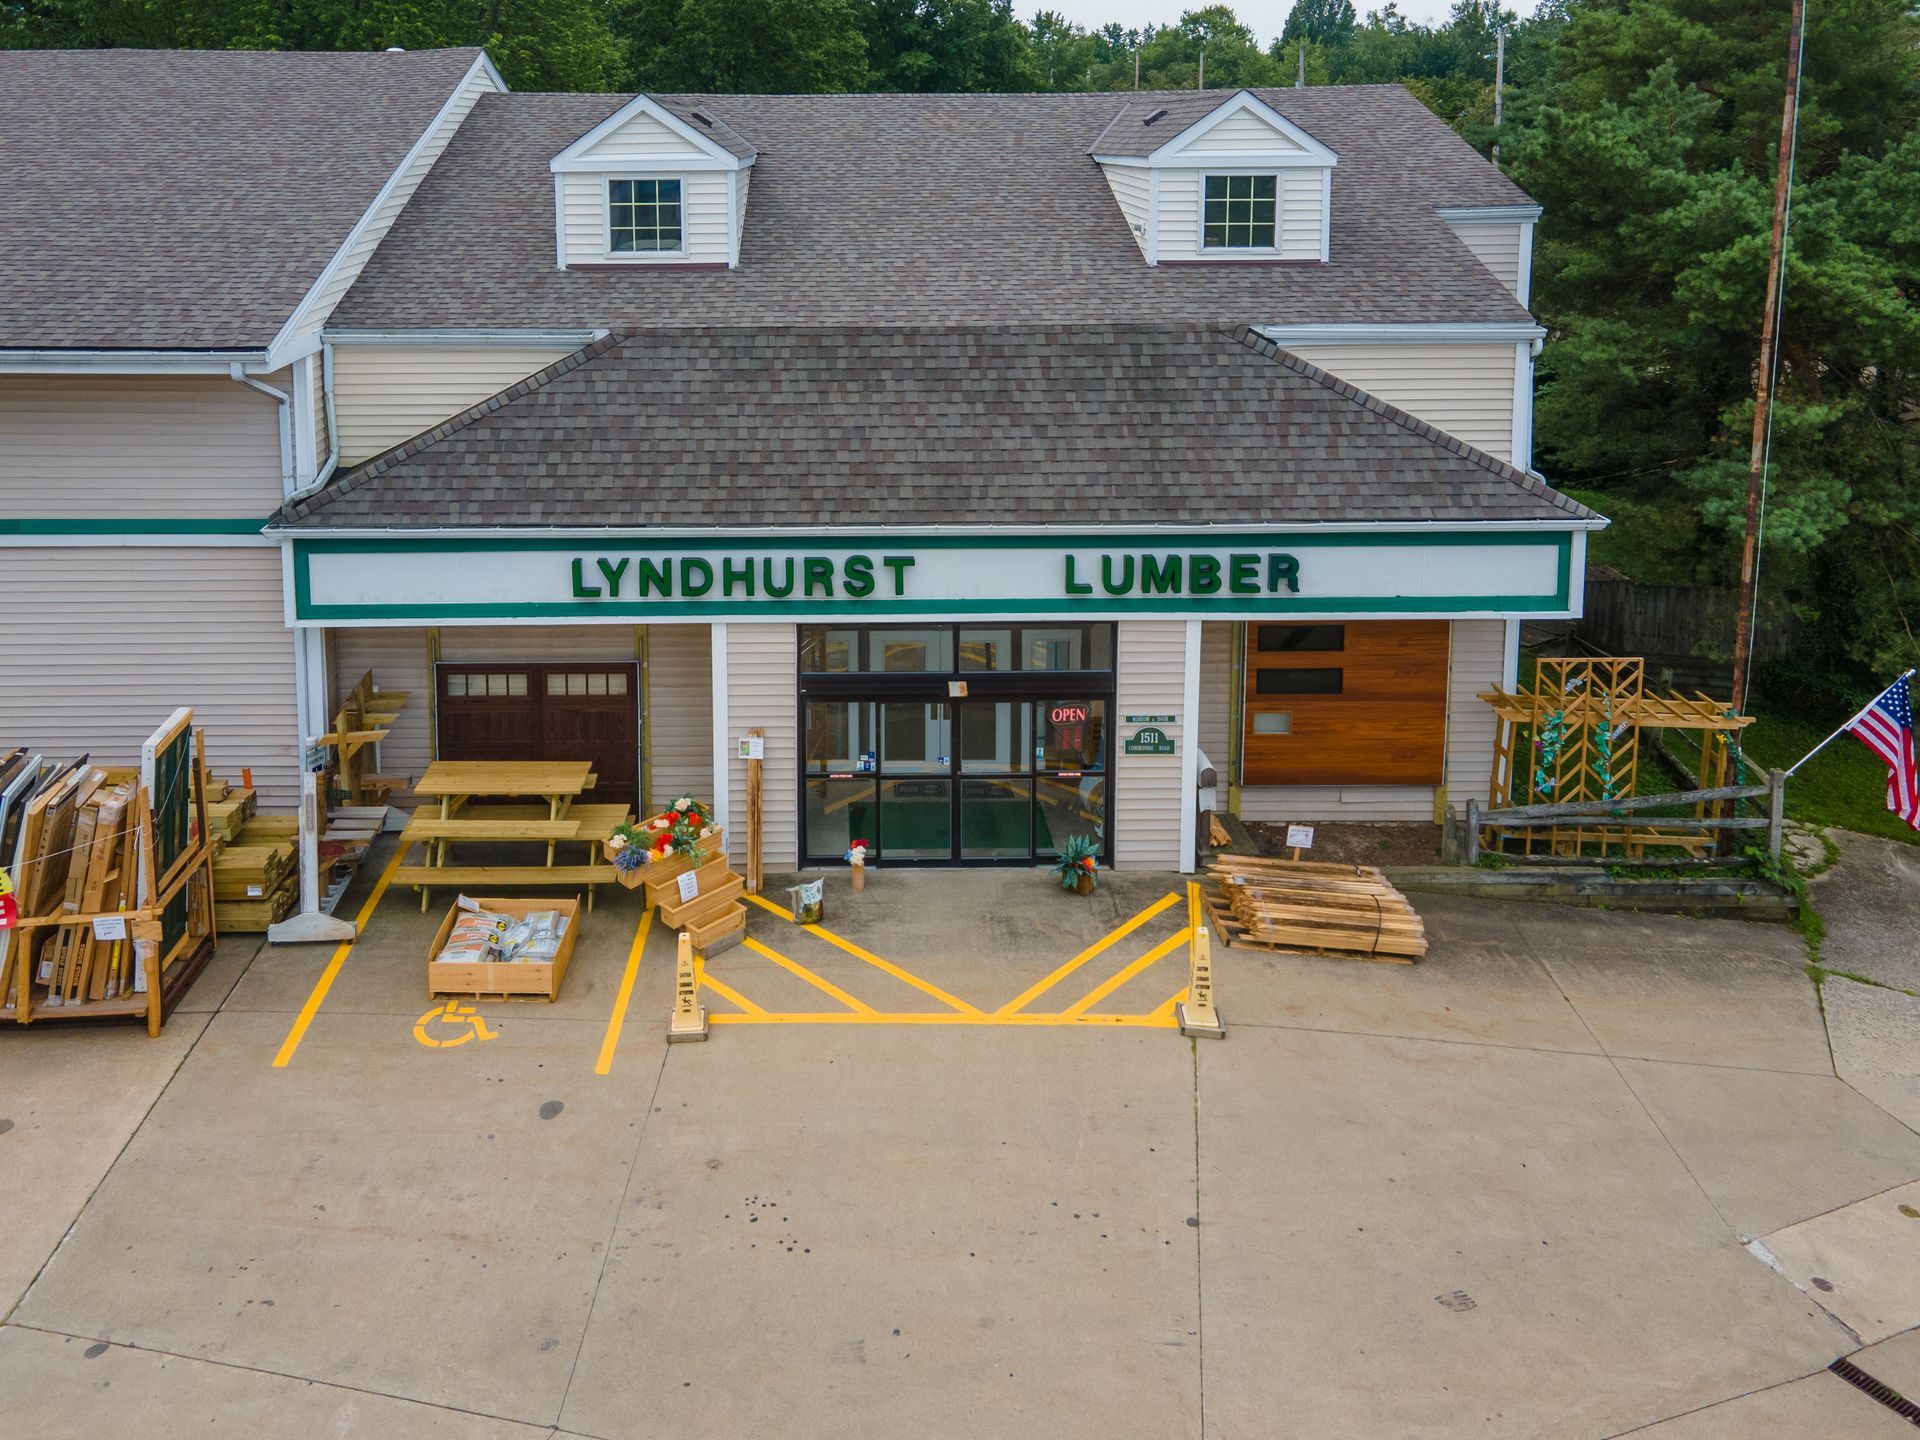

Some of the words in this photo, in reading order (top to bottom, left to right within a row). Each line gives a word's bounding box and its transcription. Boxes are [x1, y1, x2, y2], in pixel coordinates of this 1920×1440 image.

[571, 554, 916, 598] LYNDHURST
[1064, 553, 1301, 596] LUMBER
[1052, 708, 1086, 721] OPEN
[1140, 732, 1159, 743] 1511
